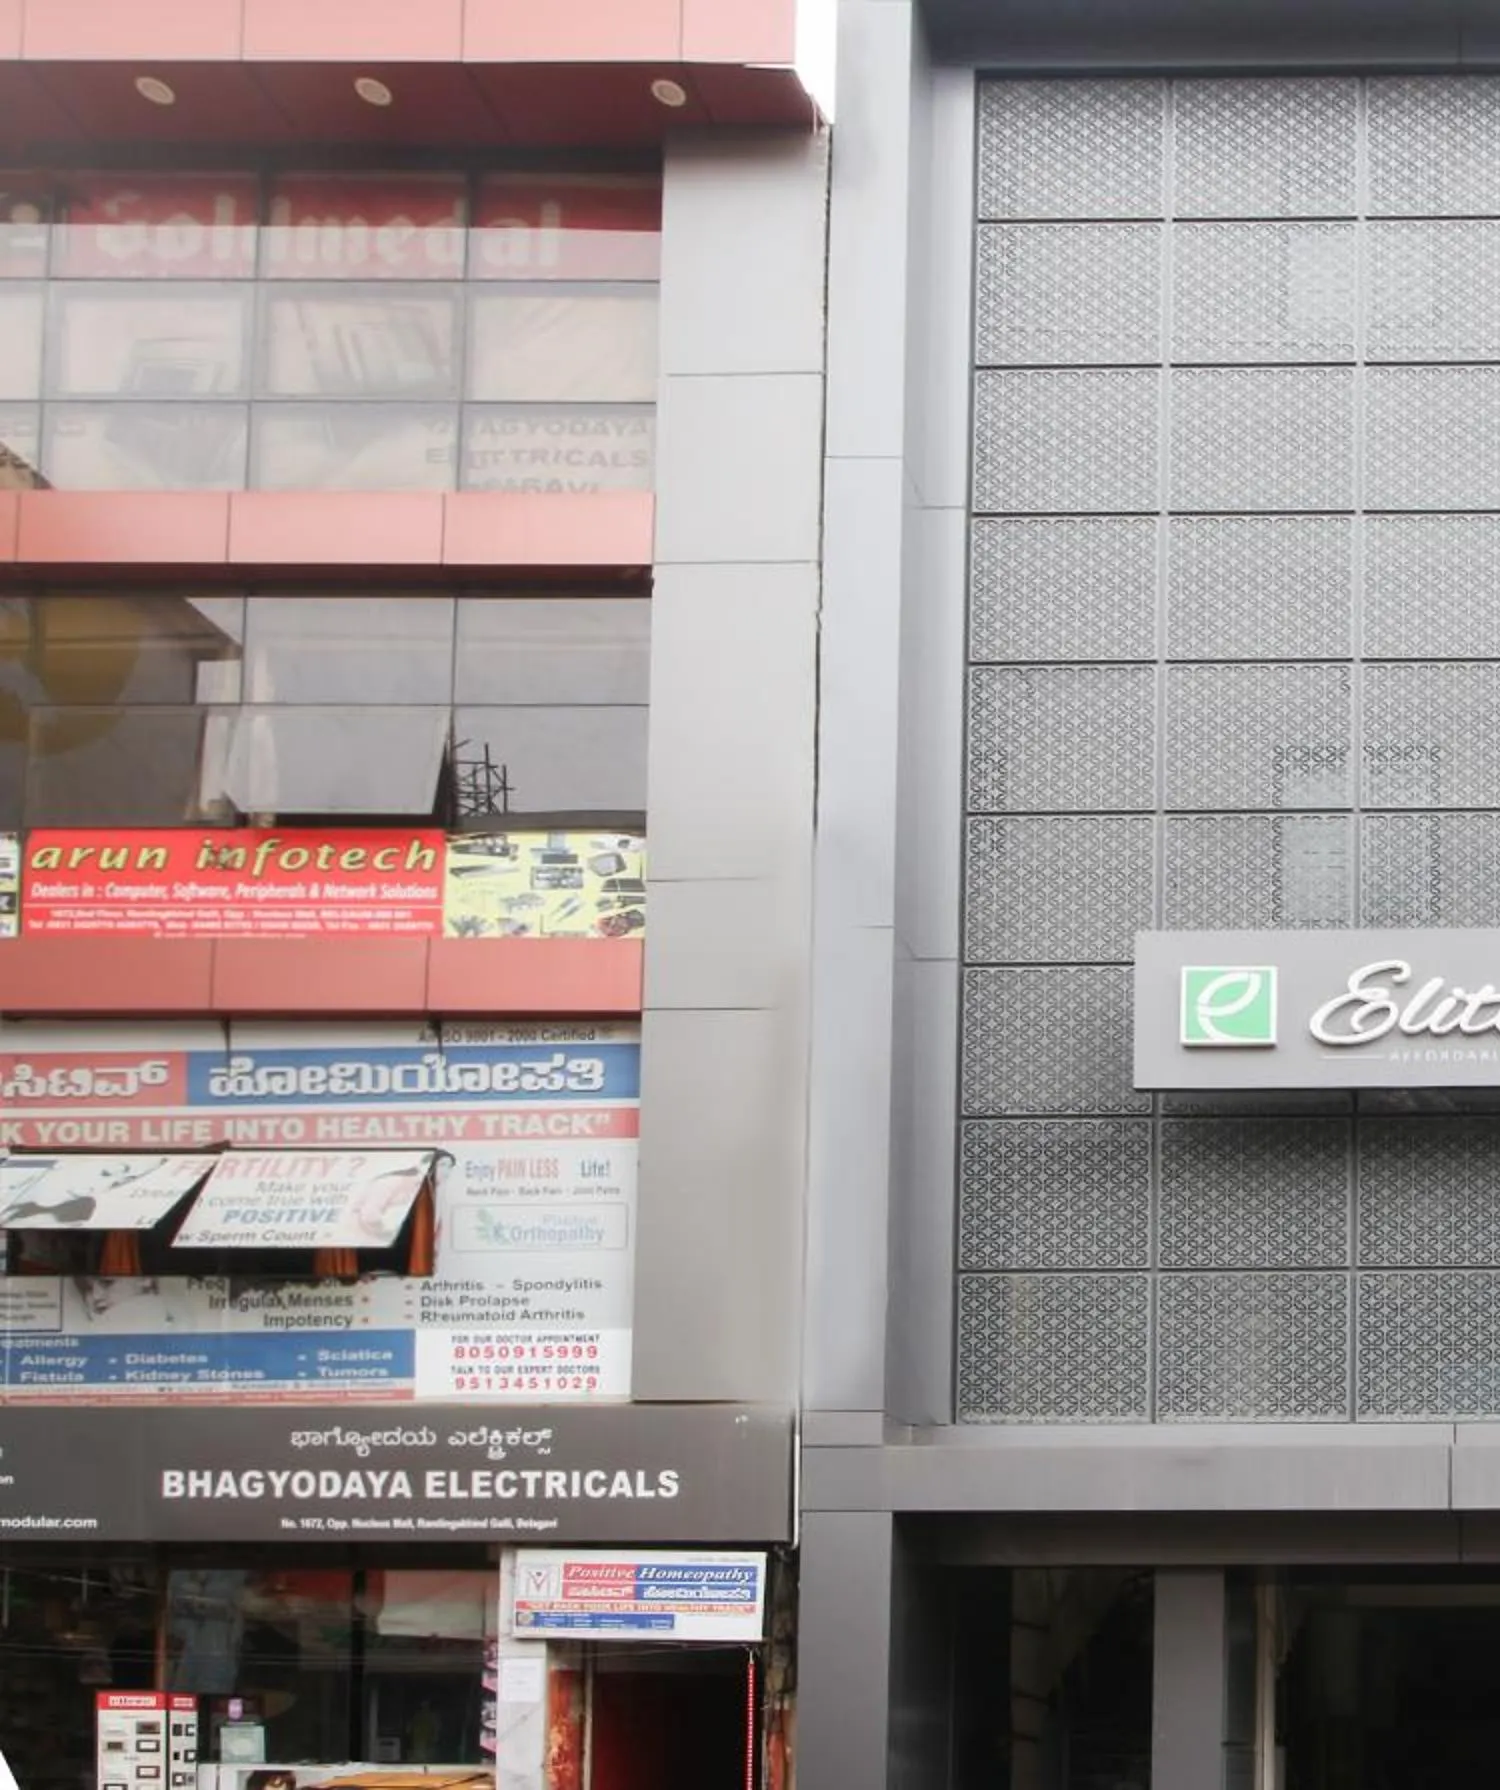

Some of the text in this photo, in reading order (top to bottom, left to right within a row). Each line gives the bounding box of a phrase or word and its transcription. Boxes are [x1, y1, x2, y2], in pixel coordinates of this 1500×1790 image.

[30, 838, 437, 878] arun infotech
[34, 1120, 130, 1145] YOUR
[141, 1119, 213, 1142] LIFE
[223, 1117, 305, 1141] INTO
[316, 1114, 472, 1140] HEALTHY
[222, 1207, 341, 1225] POSITIVE
[196, 1229, 258, 1246] Sperm
[261, 1228, 318, 1243] Count
[420, 1278, 604, 1294] Arthritis Spondylitis
[420, 1294, 531, 1309] Disk Prolapse
[262, 1312, 354, 1330] Impotency
[420, 1309, 586, 1323] Rheumatoid Arthritis
[20, 1348, 394, 1369] Allergy Diabetes Sciatica
[20, 1370, 85, 1383] Fistula
[124, 1369, 193, 1384] Kidney
[316, 1366, 390, 1378] Tumors
[161, 1470, 681, 1499] BHAGYODAYA ELECTRICALS
[567, 1565, 753, 1585] Positive Homeopathy
